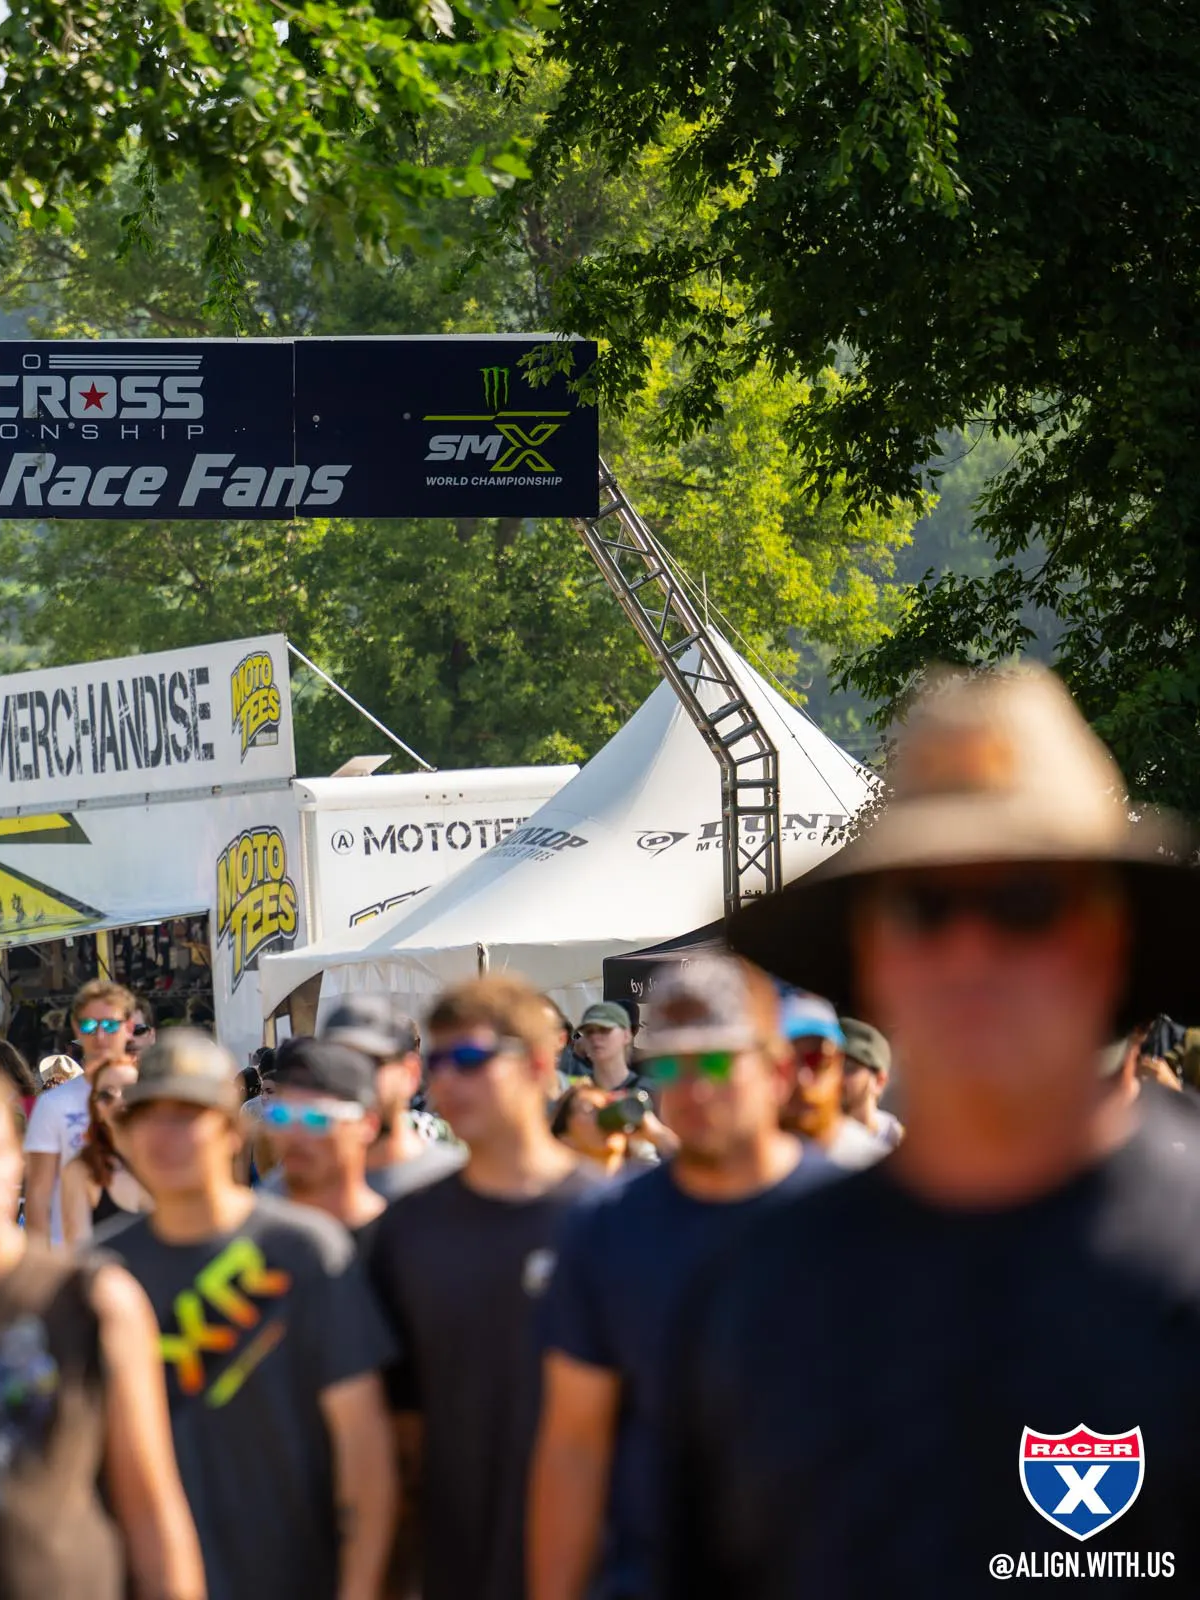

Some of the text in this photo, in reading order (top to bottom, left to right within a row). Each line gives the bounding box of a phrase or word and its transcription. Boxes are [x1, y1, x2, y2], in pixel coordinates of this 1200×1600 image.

[423, 423, 561, 472] SMX
[178, 453, 352, 507] Fans
[426, 476, 563, 486] WORLD CHAMPIONSHIP
[231, 653, 272, 726] MOTO
[240, 687, 281, 760] TEES
[217, 832, 286, 934] MOTO
[230, 880, 297, 985] TEES
[630, 979, 644, 997] by
